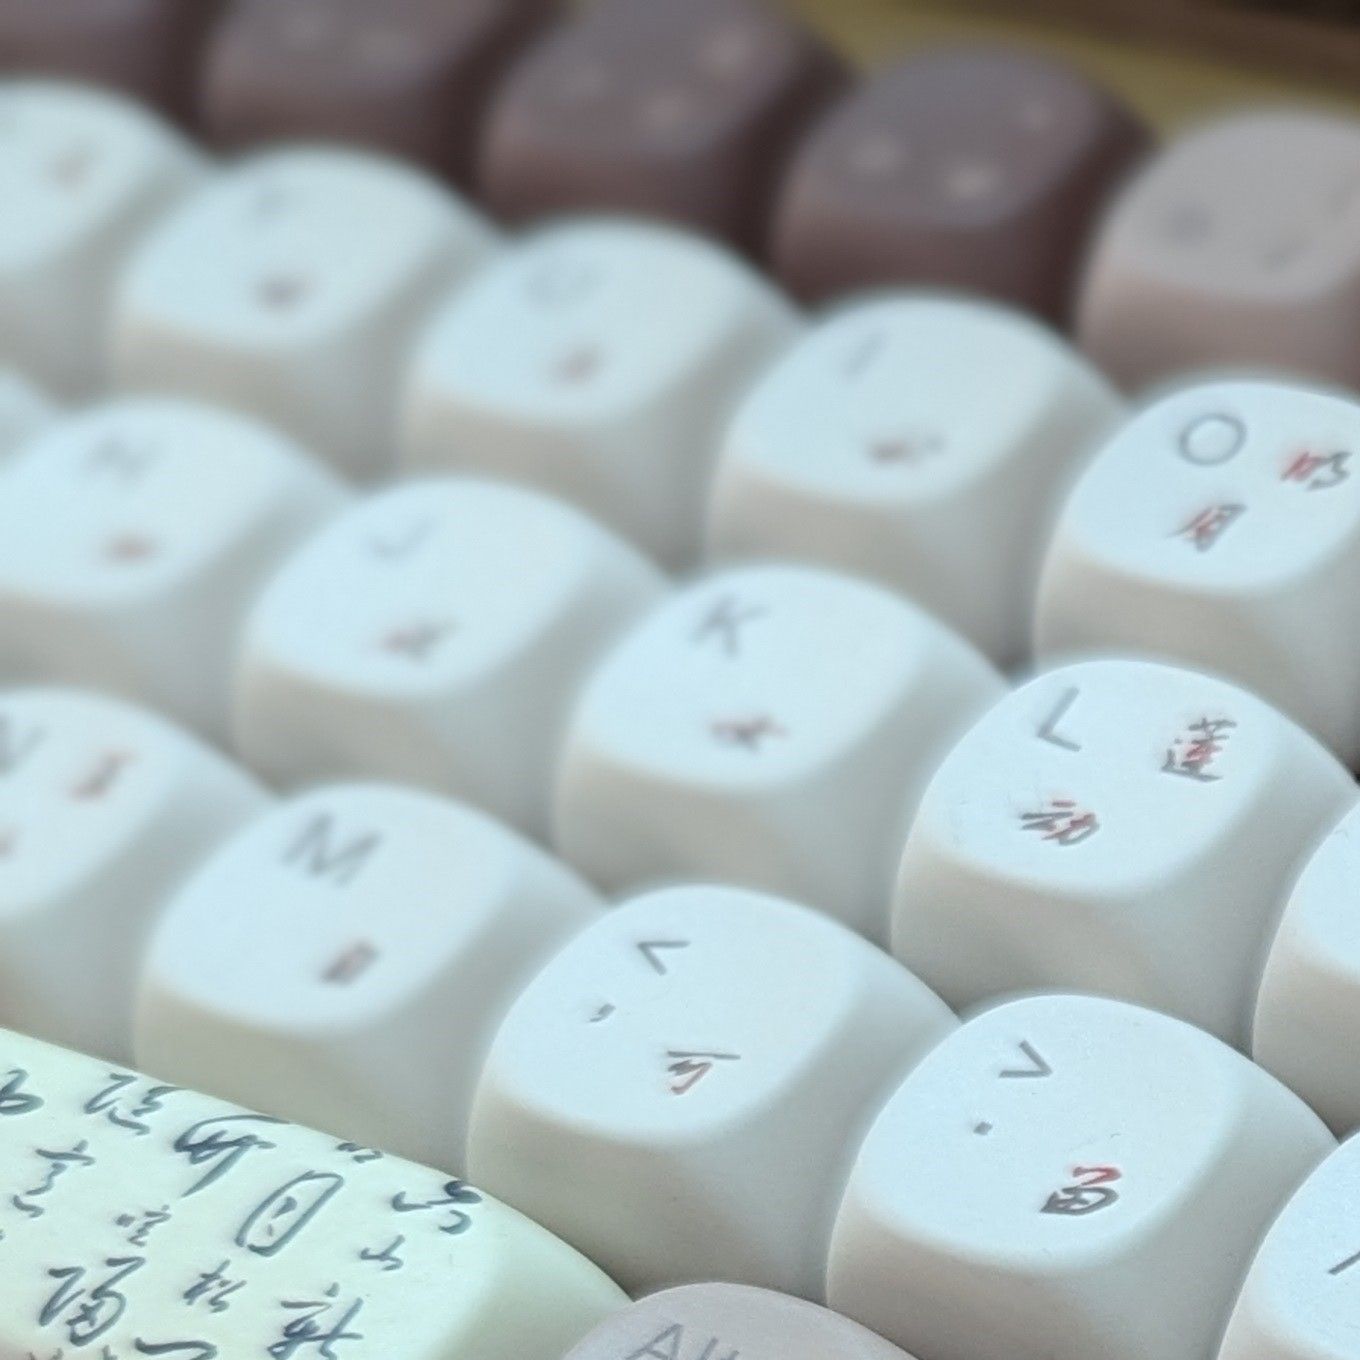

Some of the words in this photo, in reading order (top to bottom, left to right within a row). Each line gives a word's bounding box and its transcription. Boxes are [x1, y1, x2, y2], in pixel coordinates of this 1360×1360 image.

[1178, 413, 1247, 466] O
[1037, 686, 1082, 752] L
[637, 940, 691, 976] <
[999, 1040, 1053, 1079] >
